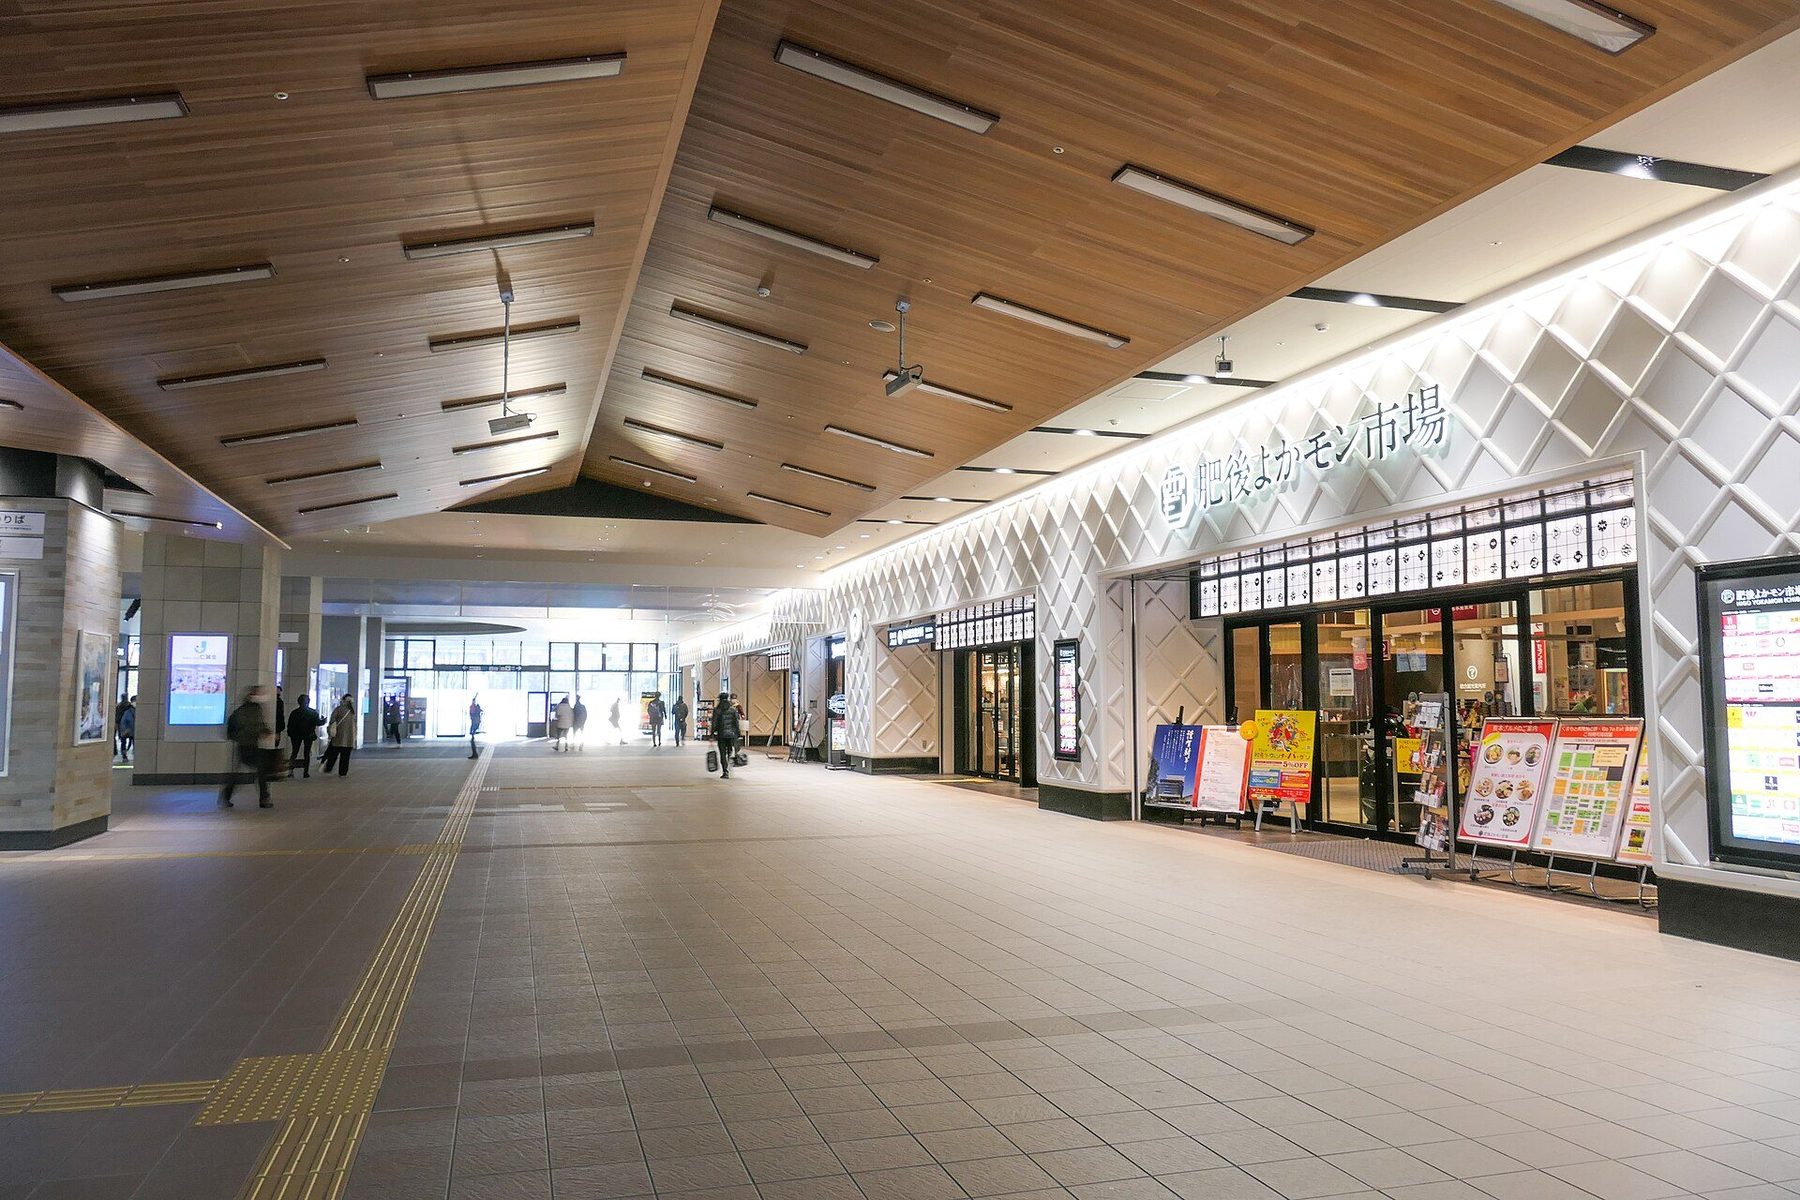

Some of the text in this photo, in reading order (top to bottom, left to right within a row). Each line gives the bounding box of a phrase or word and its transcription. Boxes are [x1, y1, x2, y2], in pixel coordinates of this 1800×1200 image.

[1199, 384, 1446, 509] 肥後よかモン市場
[0, 514, 25, 525] りば
